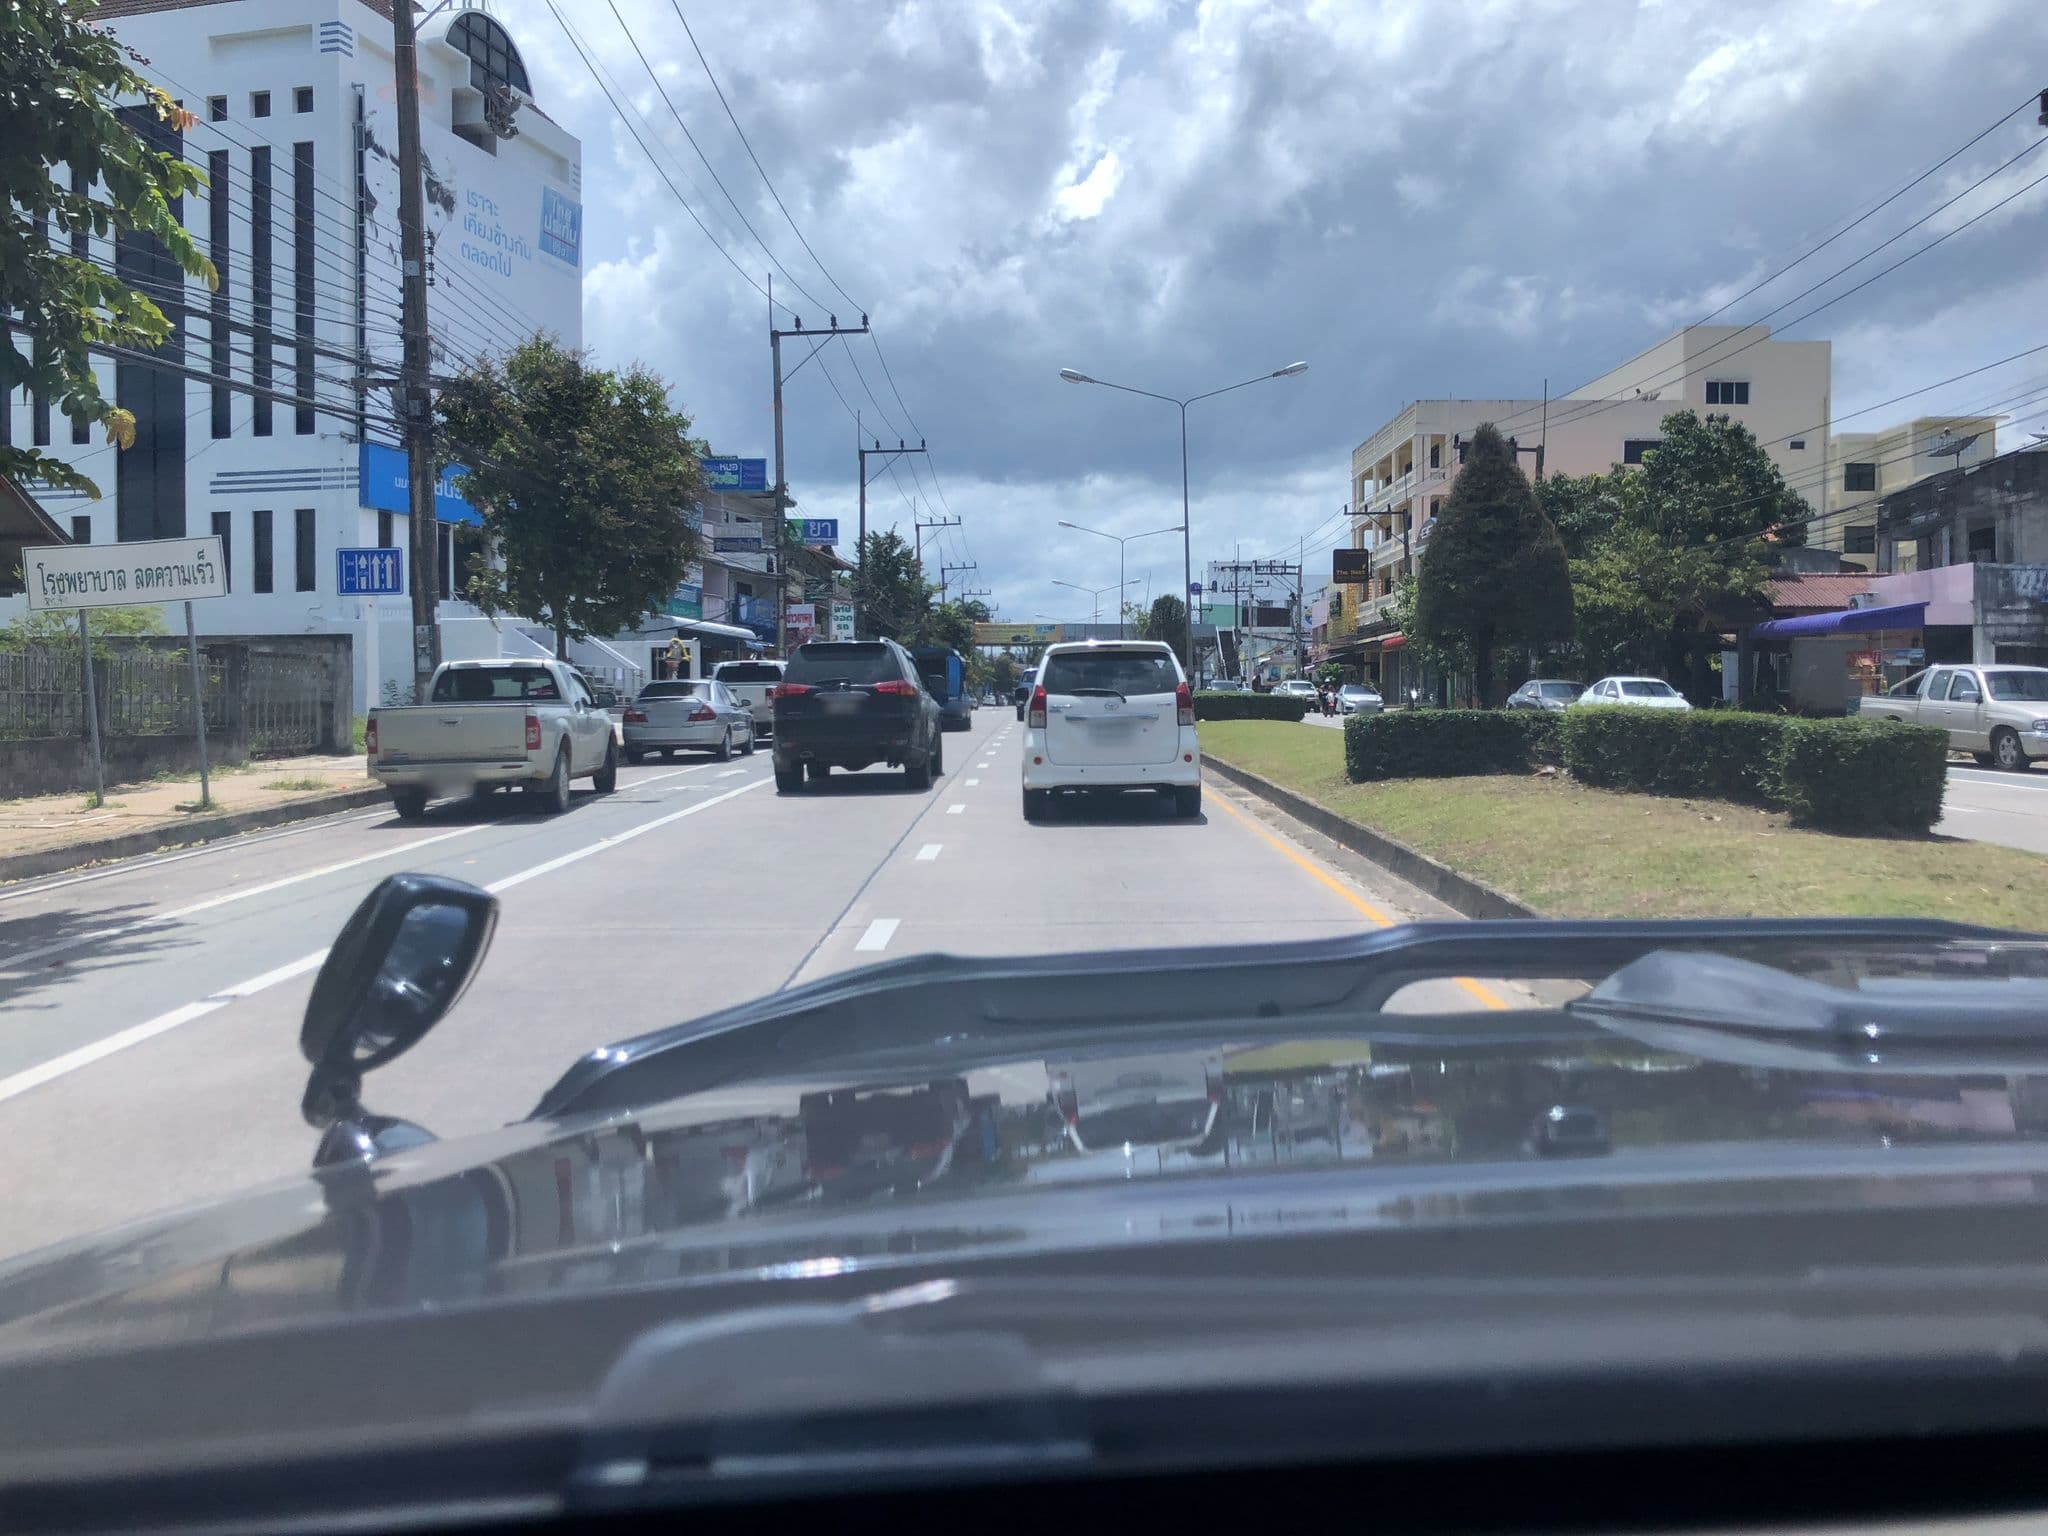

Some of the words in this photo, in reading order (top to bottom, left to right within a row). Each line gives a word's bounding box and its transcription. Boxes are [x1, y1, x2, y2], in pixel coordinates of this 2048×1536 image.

[467, 190, 499, 217] เราจะ
[464, 212, 531, 260] เคียงข้างกัน
[461, 242, 512, 277] ตลอดไป
[809, 521, 832, 537] ยา
[36, 562, 127, 596] โรงพยาบาล
[134, 549, 216, 590] ลดความเร็ว
